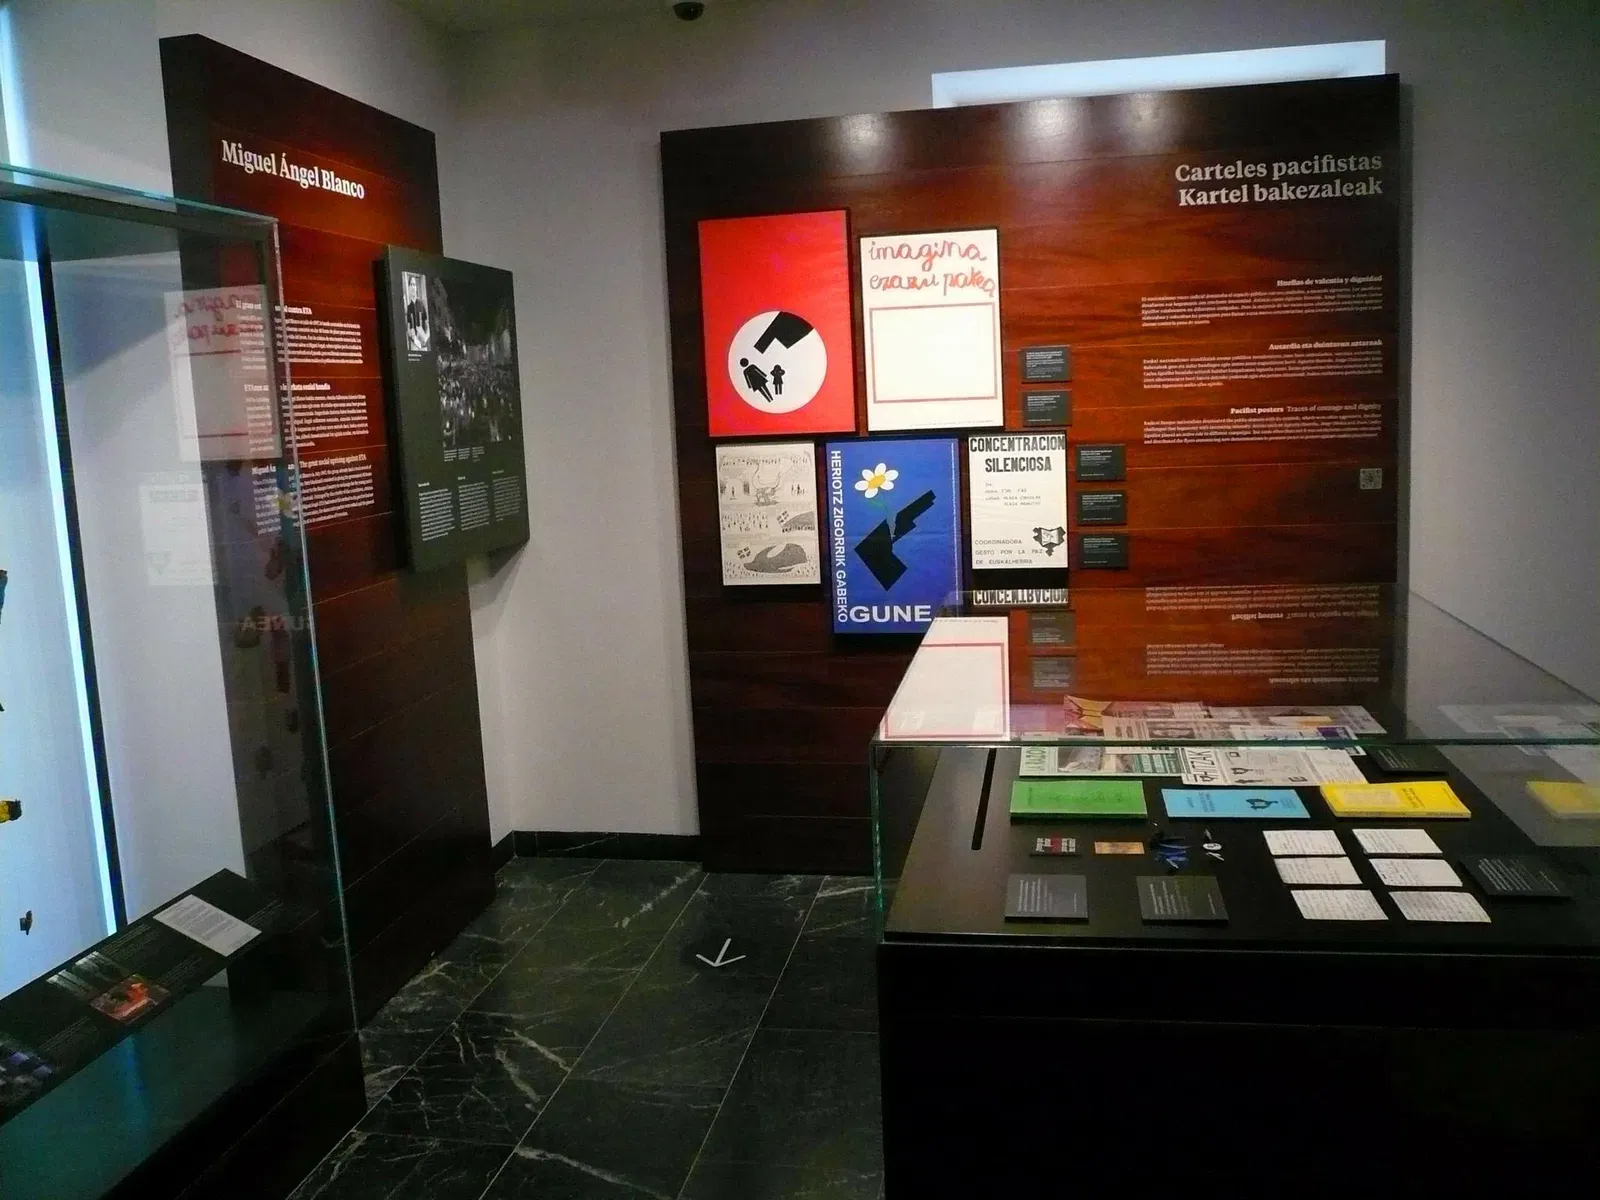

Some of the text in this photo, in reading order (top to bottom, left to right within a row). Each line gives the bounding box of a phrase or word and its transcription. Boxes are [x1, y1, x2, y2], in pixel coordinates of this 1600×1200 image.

[221, 139, 365, 200] Miguel Ángel Blanco
[1174, 154, 1382, 183] Carteles pacifistas
[1178, 177, 1383, 207] Kartel bakezaleak
[869, 240, 987, 272] imagina
[1230, 407, 1257, 415] Pacifist
[1257, 406, 1284, 415] posters
[969, 435, 1066, 453] CONCENTRACION
[985, 456, 1052, 473] SILENCIOSA
[831, 450, 848, 623] HERIOTZ ZIGORRIK GABEKO
[849, 605, 932, 623] GUNE
